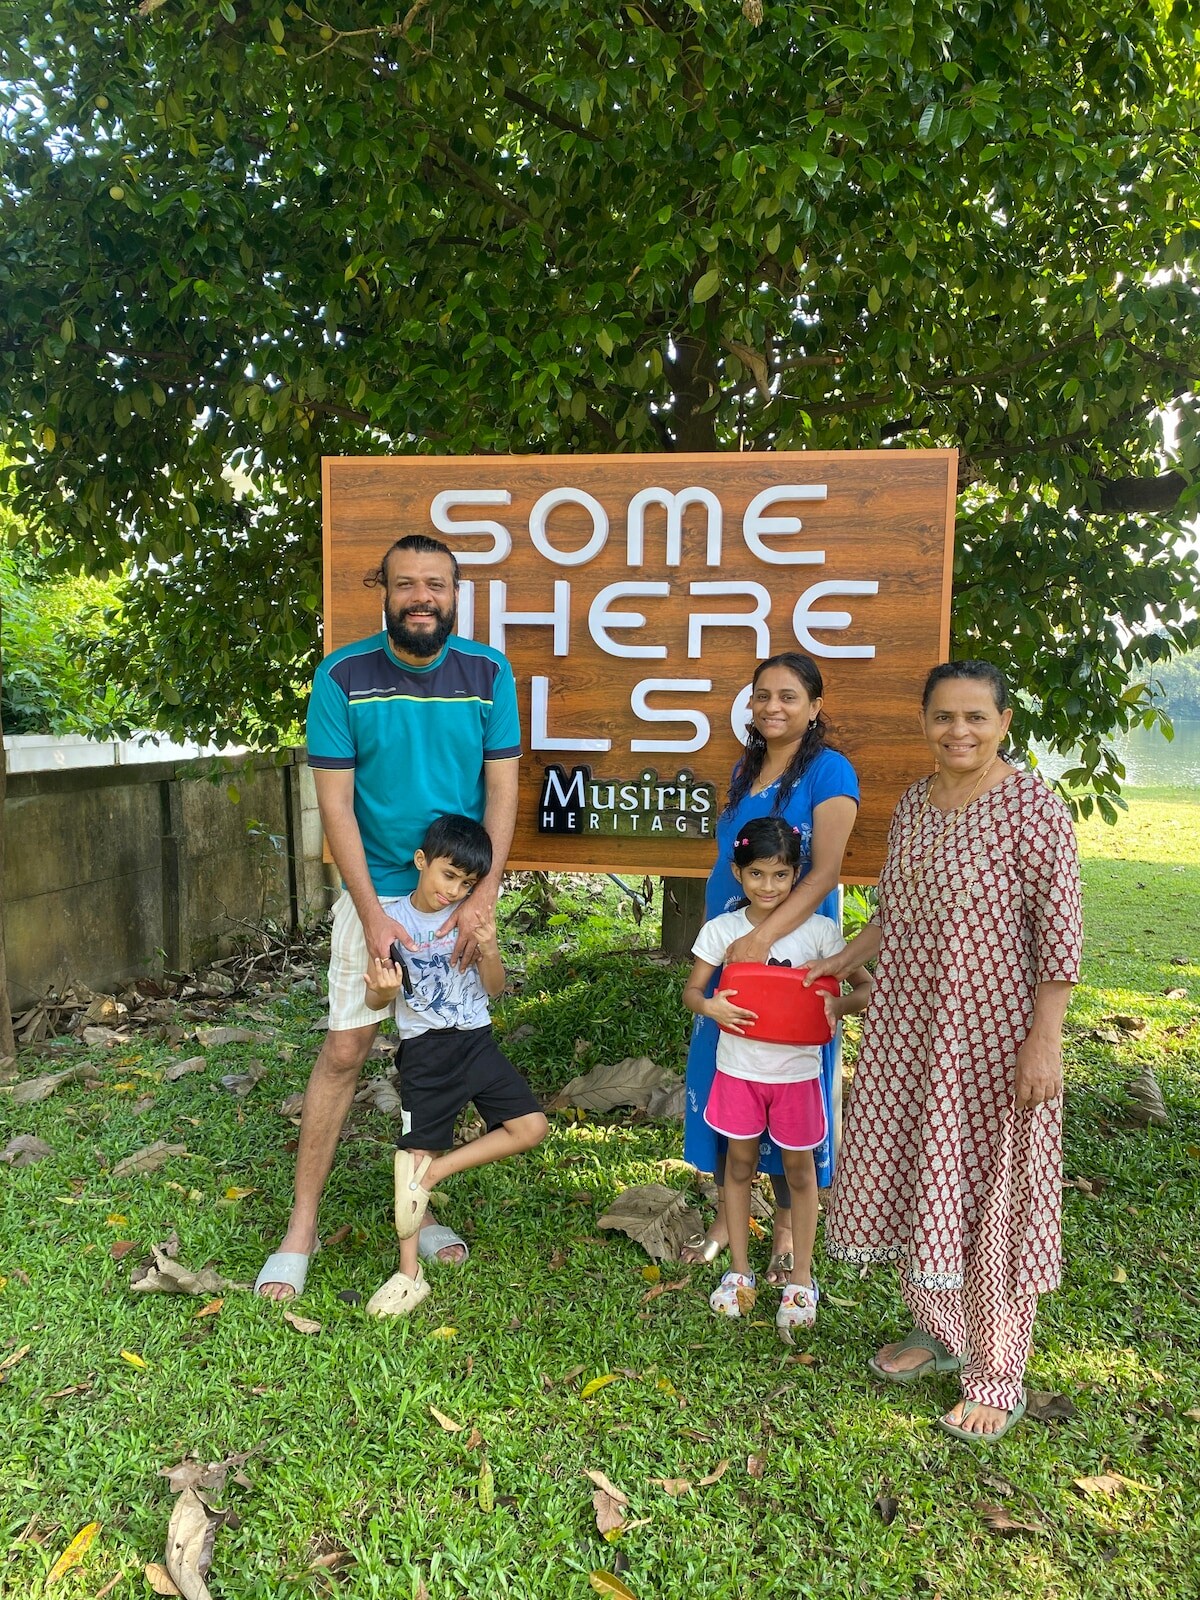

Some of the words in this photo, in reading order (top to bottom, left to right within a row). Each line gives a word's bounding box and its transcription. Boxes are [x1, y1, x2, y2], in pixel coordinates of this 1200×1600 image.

[430, 484, 828, 566] SOME
[382, 579, 879, 659] HERE
[513, 675, 754, 753] LS
[542, 811, 710, 833] HERITAGE
[543, 769, 711, 814] Musiris
